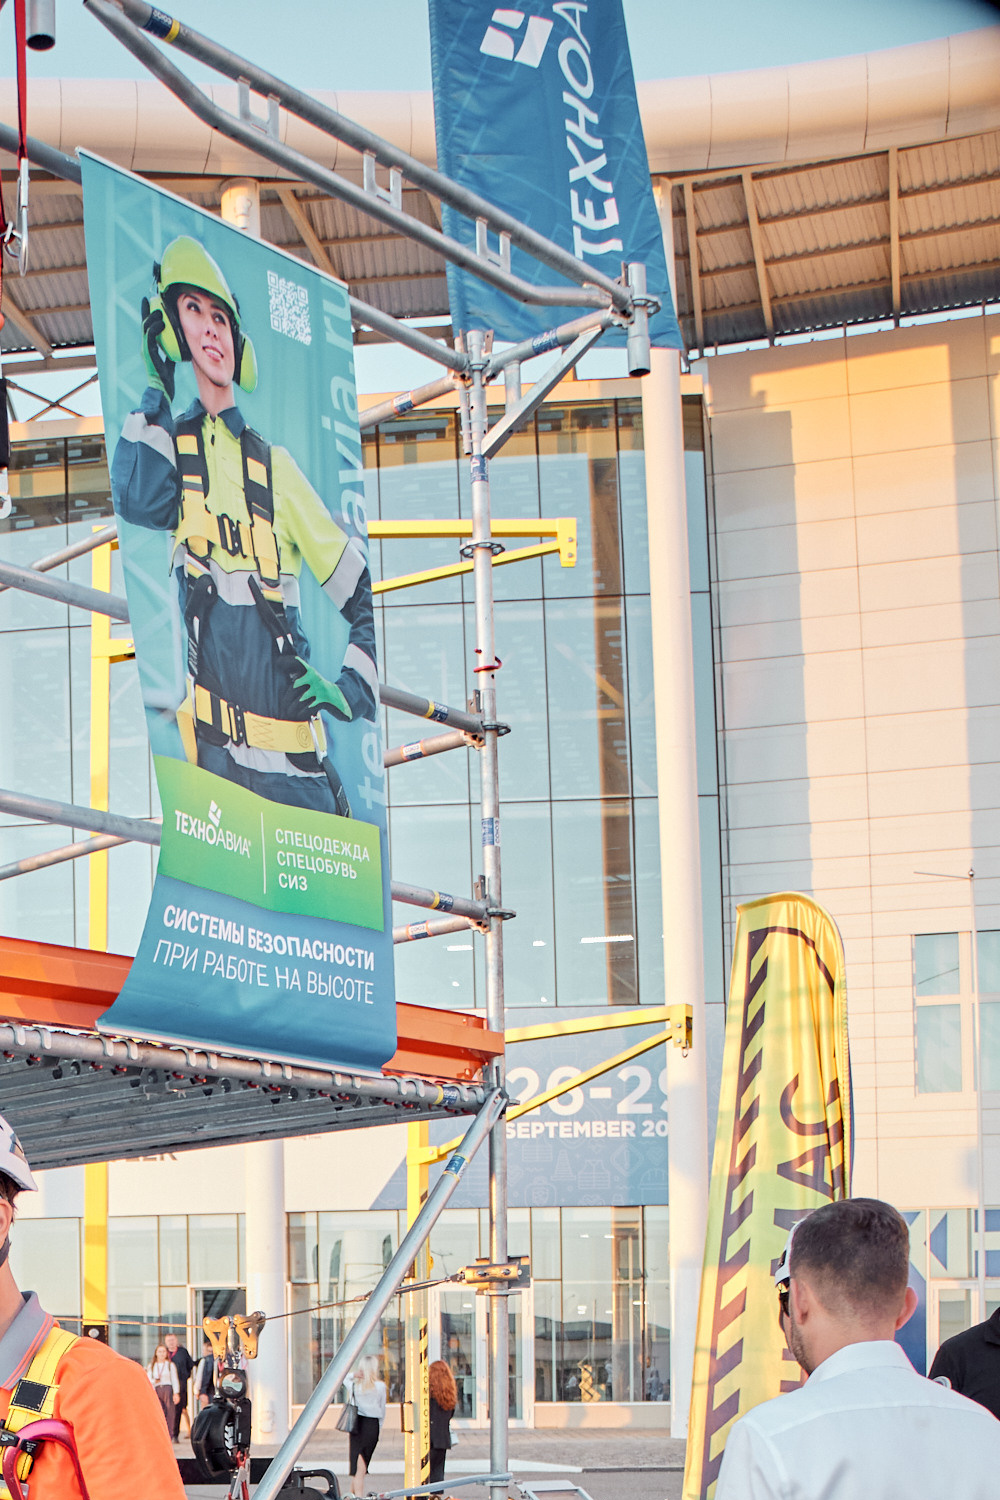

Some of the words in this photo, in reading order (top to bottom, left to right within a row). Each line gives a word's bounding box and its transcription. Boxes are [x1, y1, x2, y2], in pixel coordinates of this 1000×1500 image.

[174, 809, 251, 859] ТЕХНОАВИА
[275, 828, 370, 862] СПЕЦОДЕЖДА
[276, 850, 357, 880] СПЕЦОБУВЬ
[278, 873, 308, 891] СИЗ
[163, 904, 244, 946] СИСТЕМЫ
[247, 927, 375, 972] БЕЗОПАСНОСТИ
[153, 939, 199, 972] ПРИ
[202, 950, 269, 987] РАБОТЕ
[275, 966, 301, 992] НА
[307, 970, 374, 1005] ВЫСОТЕ
[506, 1120, 636, 1139] SEPTEMBER
